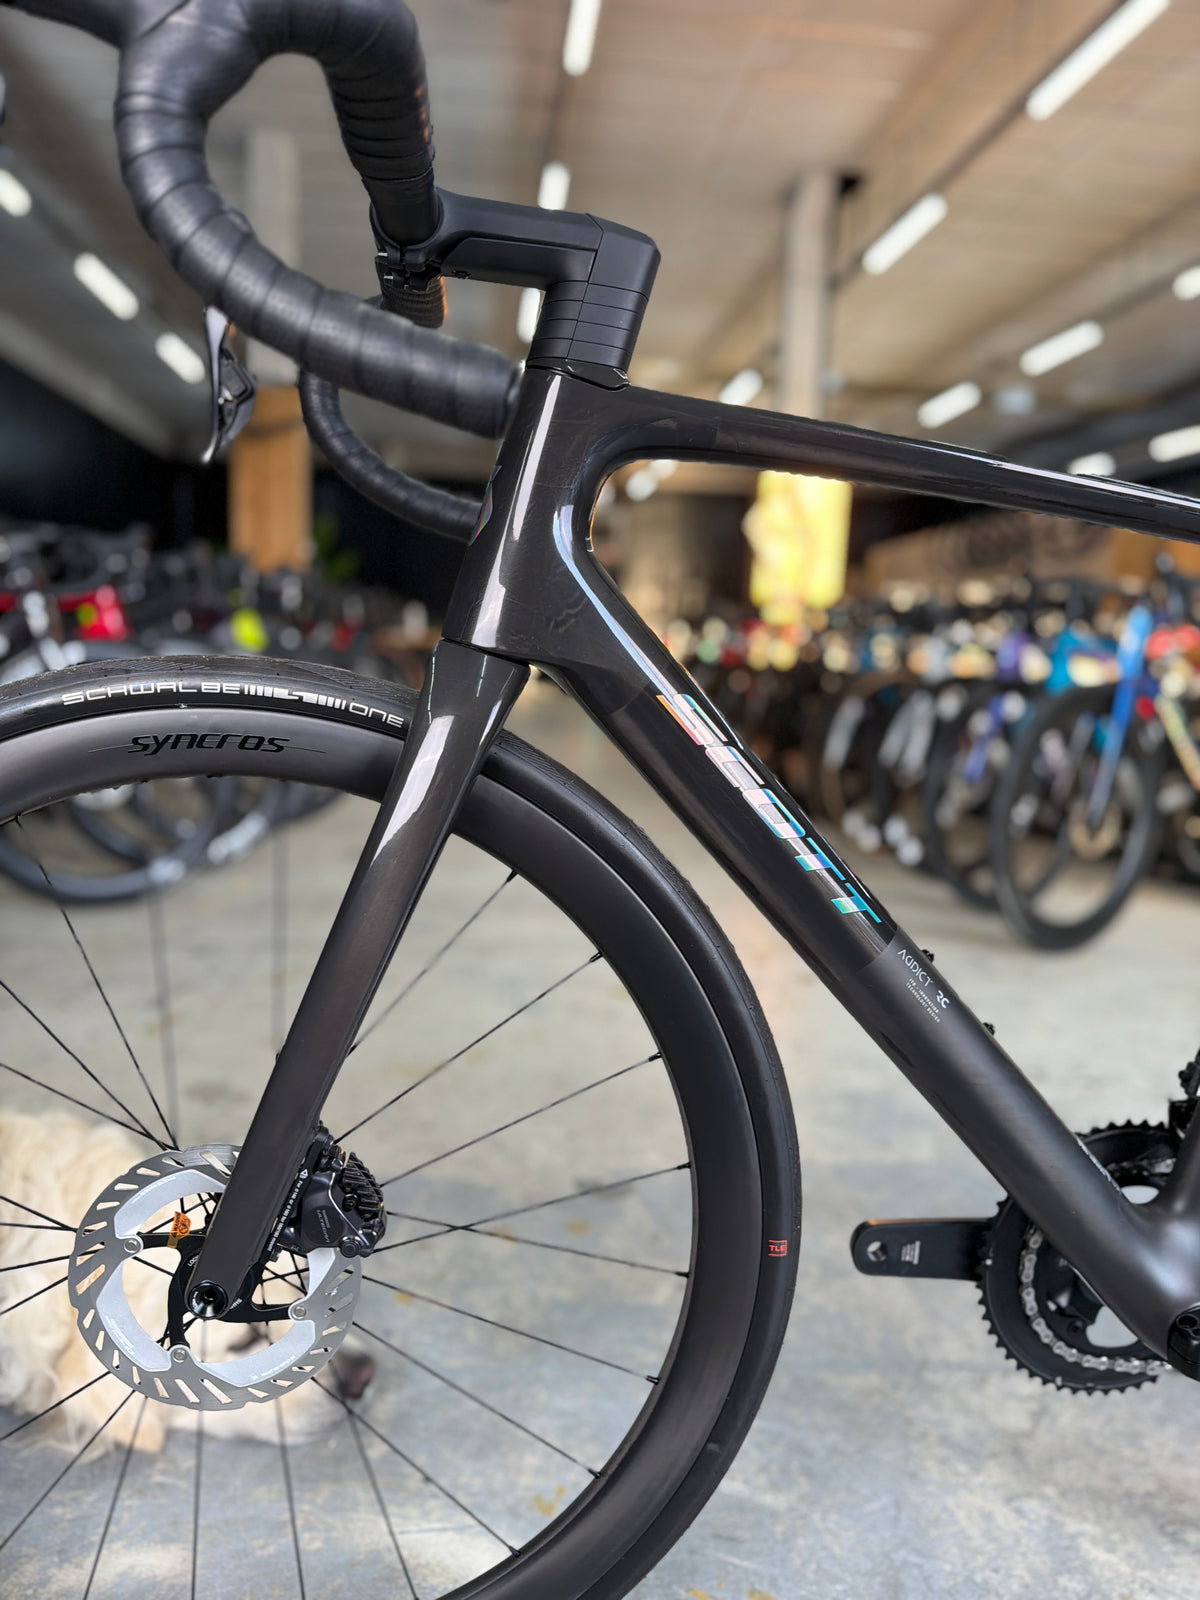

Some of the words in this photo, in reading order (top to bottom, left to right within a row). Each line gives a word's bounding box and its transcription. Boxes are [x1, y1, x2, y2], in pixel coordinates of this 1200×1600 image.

[62, 682, 240, 706] SCHWALBE
[348, 705, 404, 728] ONE
[656, 693, 882, 924] SCOTT
[897, 949, 931, 987] ADDICT
[936, 989, 950, 1009] RC
